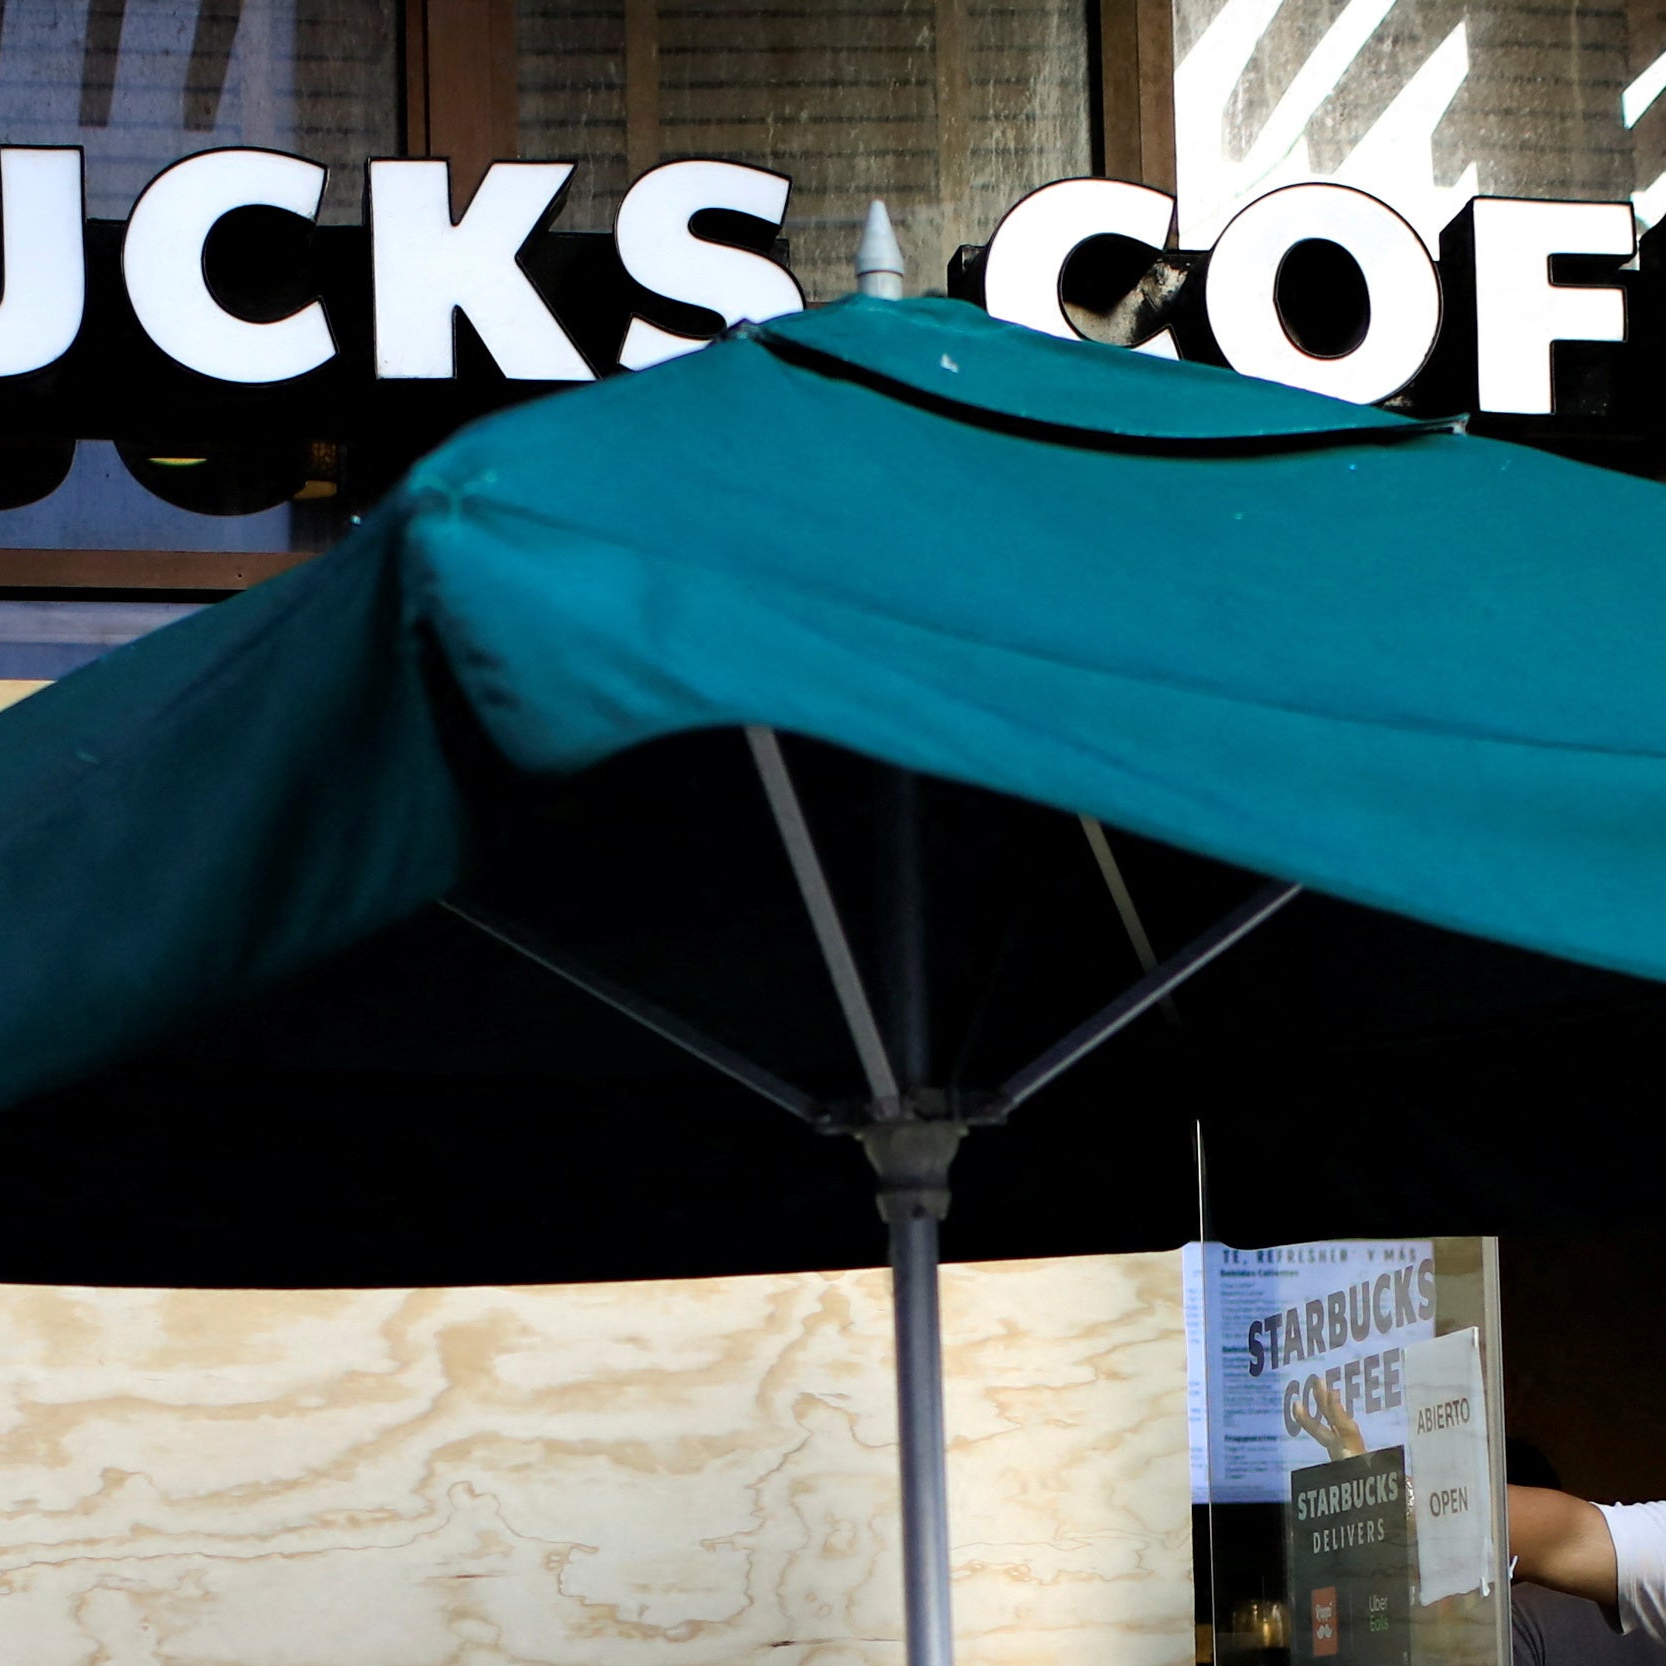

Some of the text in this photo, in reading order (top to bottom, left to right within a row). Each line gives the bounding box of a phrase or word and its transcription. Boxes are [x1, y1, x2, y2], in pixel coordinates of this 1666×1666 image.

[1248, 1258, 1436, 1378] STARBUCKS
[1283, 1347, 1402, 1438] COFFEE
[1416, 1397, 1471, 1435] ABIERTO
[1297, 1471, 1399, 1521] STARBUCKS
[1429, 1486, 1469, 1518] OPEN
[1312, 1517, 1385, 1554] DELIVERS
[1368, 1594, 1389, 1612] Uber
